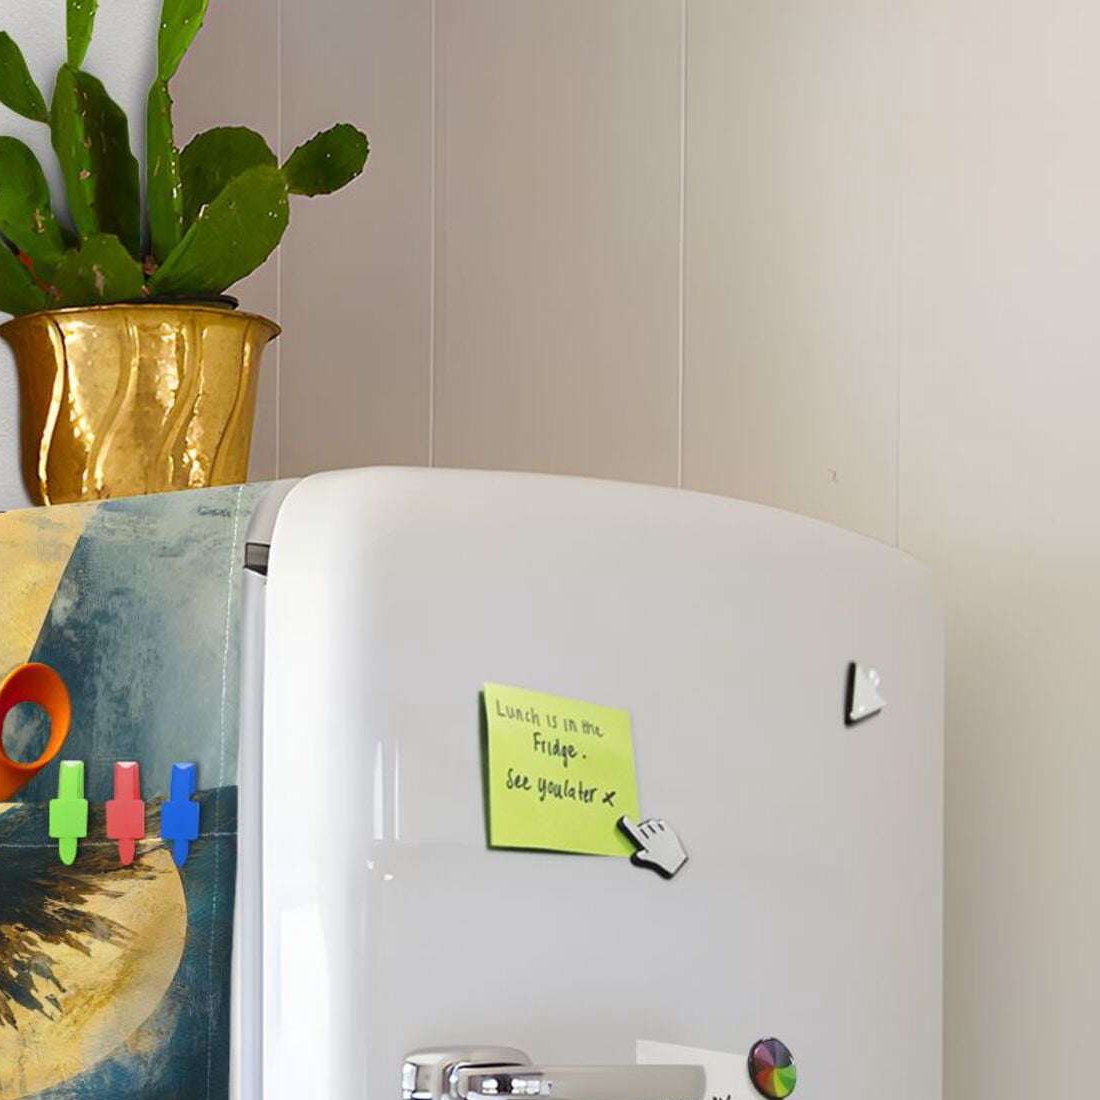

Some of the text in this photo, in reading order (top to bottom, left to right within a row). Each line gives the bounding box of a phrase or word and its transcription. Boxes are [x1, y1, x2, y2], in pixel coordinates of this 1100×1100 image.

[496, 700, 604, 737] Lunch is in the
